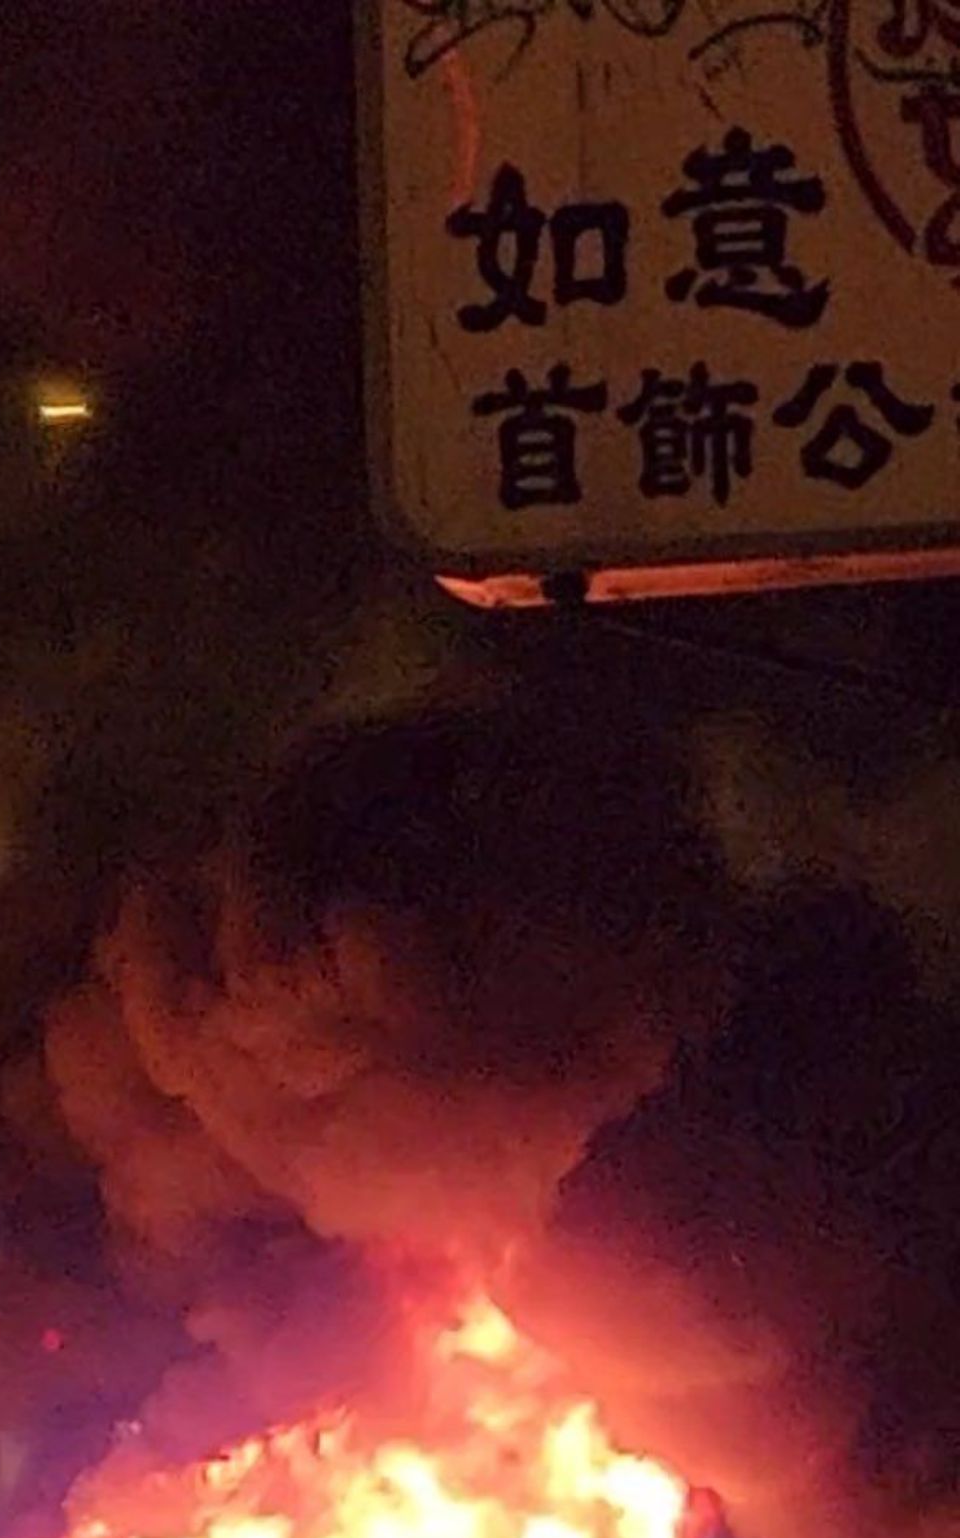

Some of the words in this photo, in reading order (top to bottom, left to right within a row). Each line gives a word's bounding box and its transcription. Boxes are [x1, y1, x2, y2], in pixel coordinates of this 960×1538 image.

[445, 124, 830, 332] 如意
[472, 361, 960, 510] 首飾公
